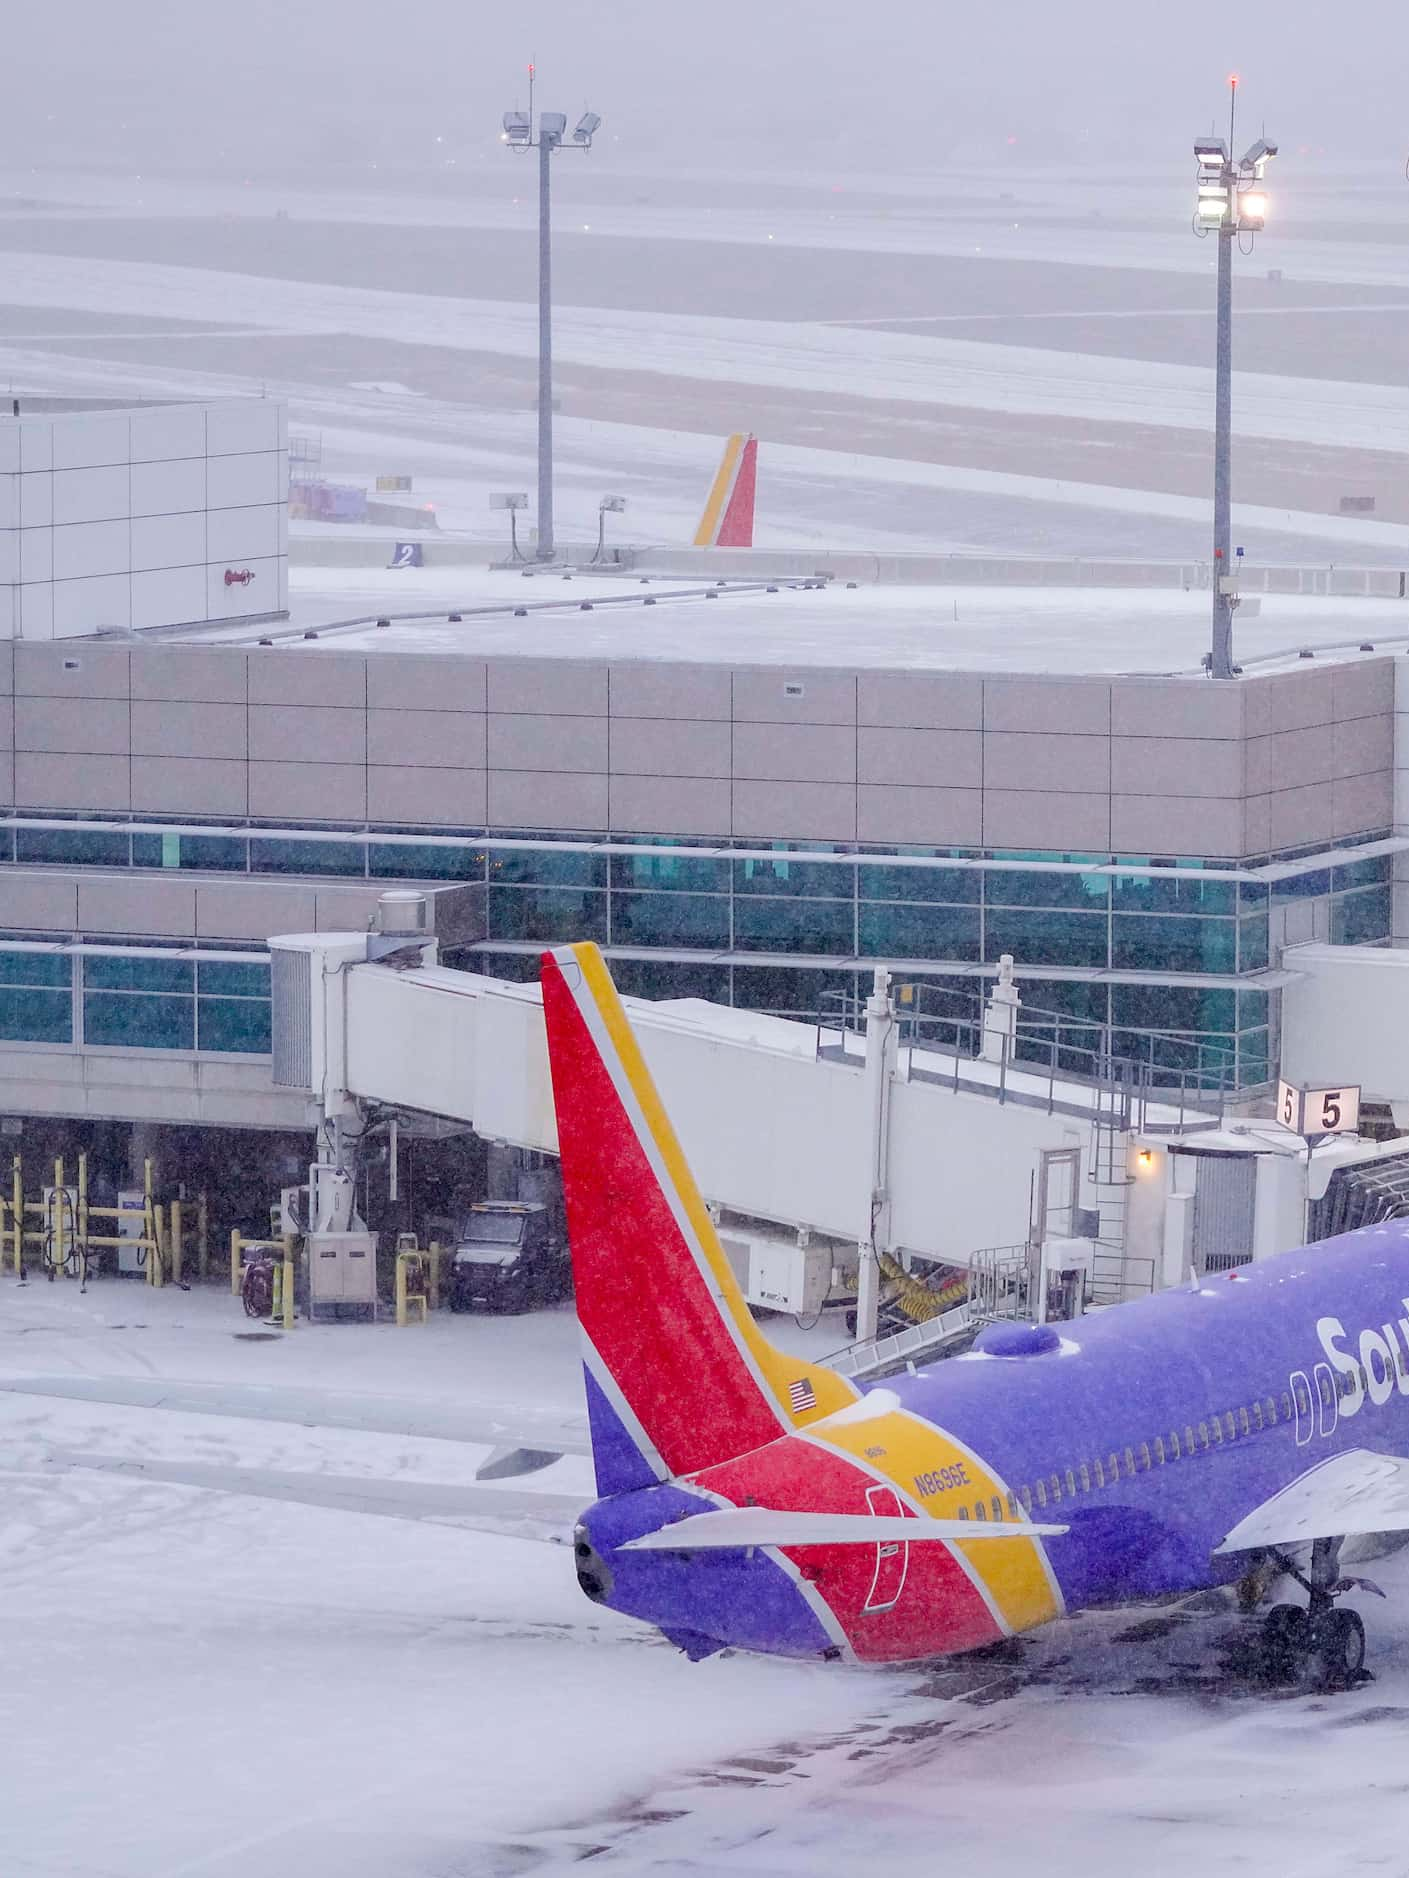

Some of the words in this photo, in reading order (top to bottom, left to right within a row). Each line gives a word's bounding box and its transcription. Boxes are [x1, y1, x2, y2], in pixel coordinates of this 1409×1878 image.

[401, 545, 414, 565] 2
[1284, 1087, 1294, 1124] 5
[1322, 1092, 1341, 1128] 5
[914, 1462, 971, 1497] N8696E
